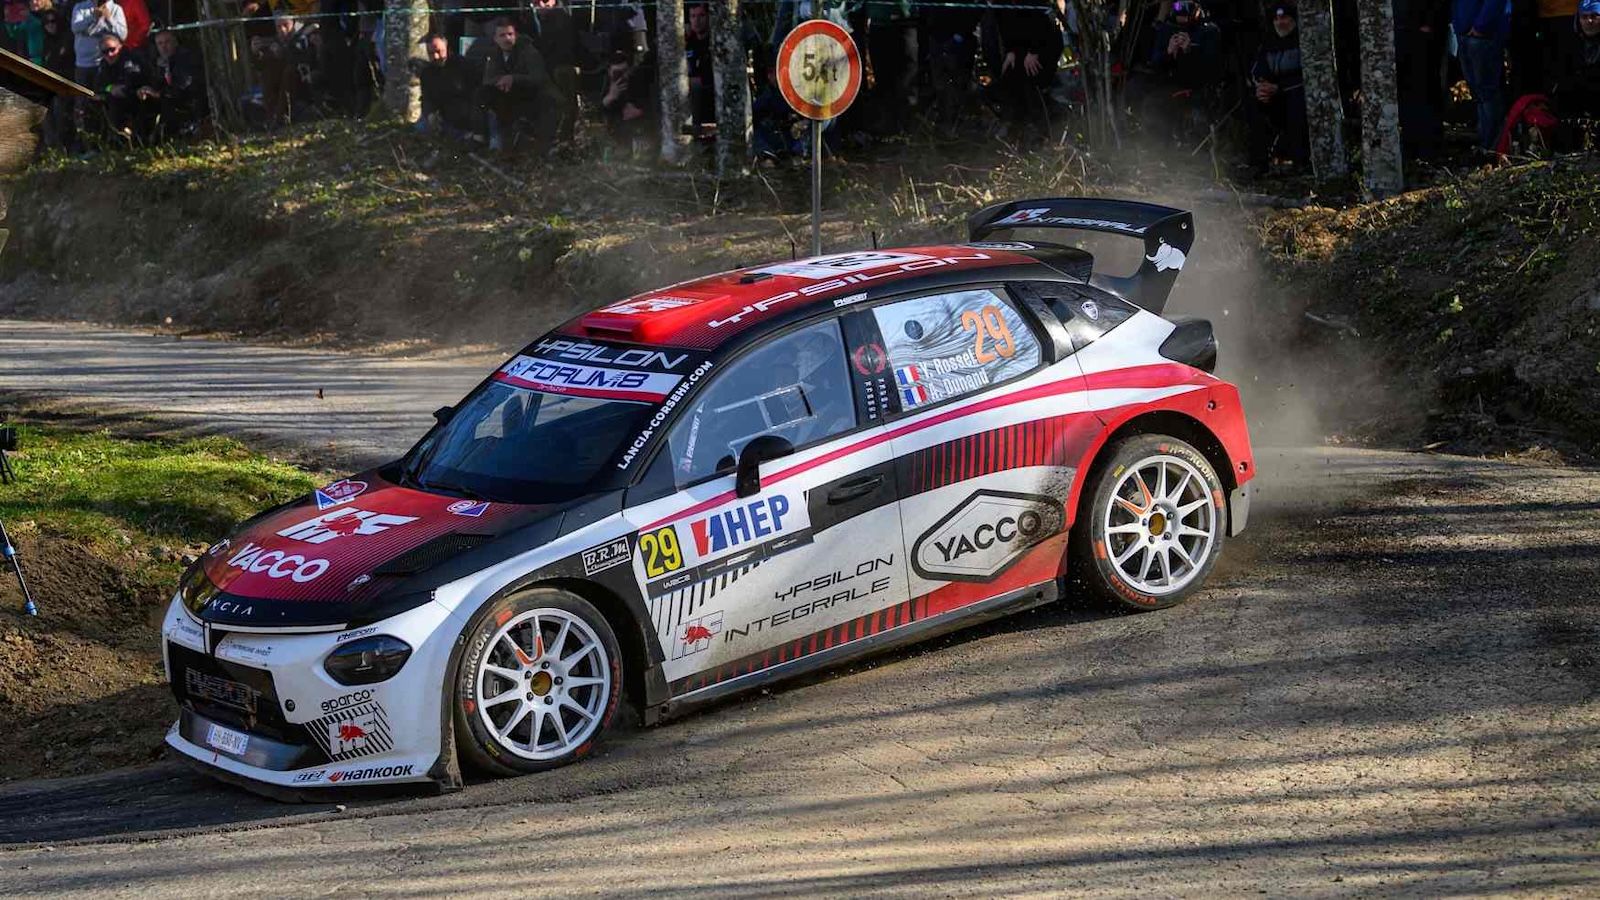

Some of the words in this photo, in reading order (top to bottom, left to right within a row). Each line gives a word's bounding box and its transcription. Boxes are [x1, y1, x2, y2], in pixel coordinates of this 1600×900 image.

[707, 253, 992, 329] YPSILON
[533, 339, 688, 370] YPSILON
[960, 304, 1017, 365] 29
[520, 361, 650, 389] FORUM8
[617, 360, 713, 471] LANCIA-CORSEHF.COM
[723, 494, 789, 547] HEP
[934, 510, 1041, 562] YACCO
[226, 542, 330, 583] YACCO
[640, 527, 684, 578] 29
[774, 553, 894, 601] YPSILON
[724, 576, 891, 643] INTEGRALE
[321, 689, 371, 714] sparco
